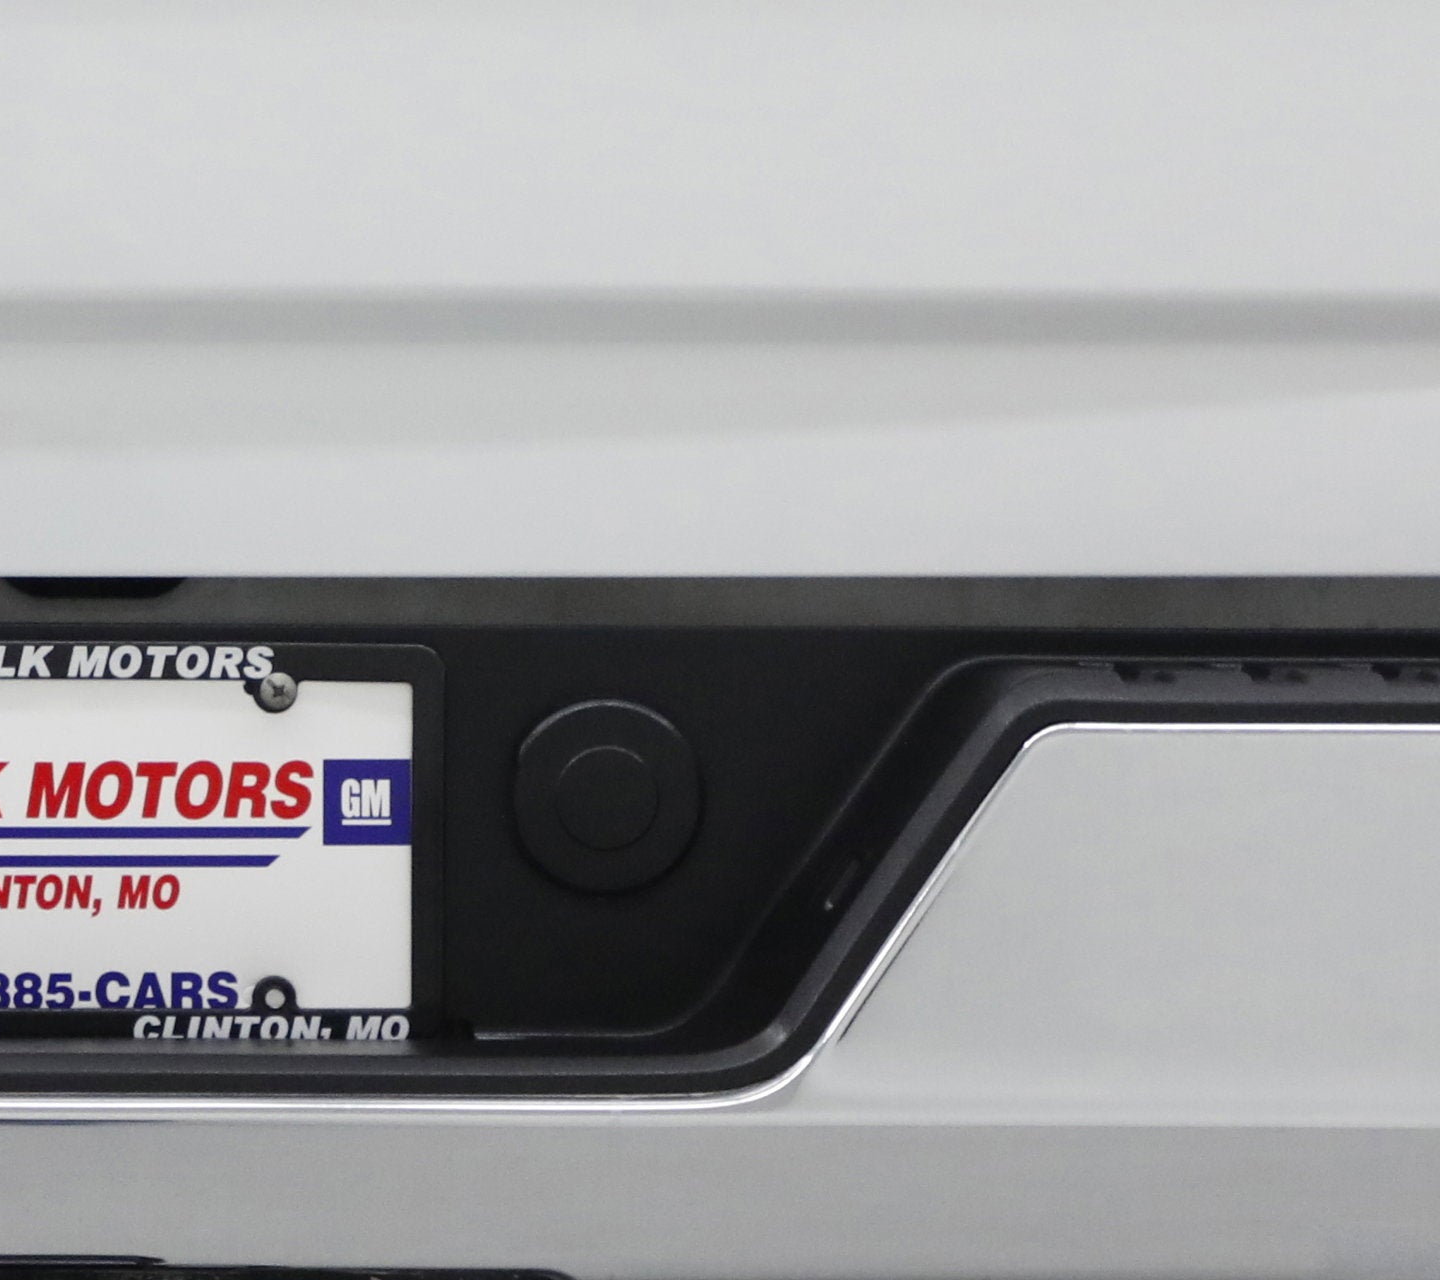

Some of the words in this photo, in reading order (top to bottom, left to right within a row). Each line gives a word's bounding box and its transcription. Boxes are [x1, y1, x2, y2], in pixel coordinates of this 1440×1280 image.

[66, 645, 275, 679] MOTORS
[26, 760, 314, 820] MOTORS
[339, 777, 391, 818] GM
[117, 874, 180, 910] MO
[132, 1014, 333, 1040] CLINTON,
[345, 1014, 411, 1041] MO
